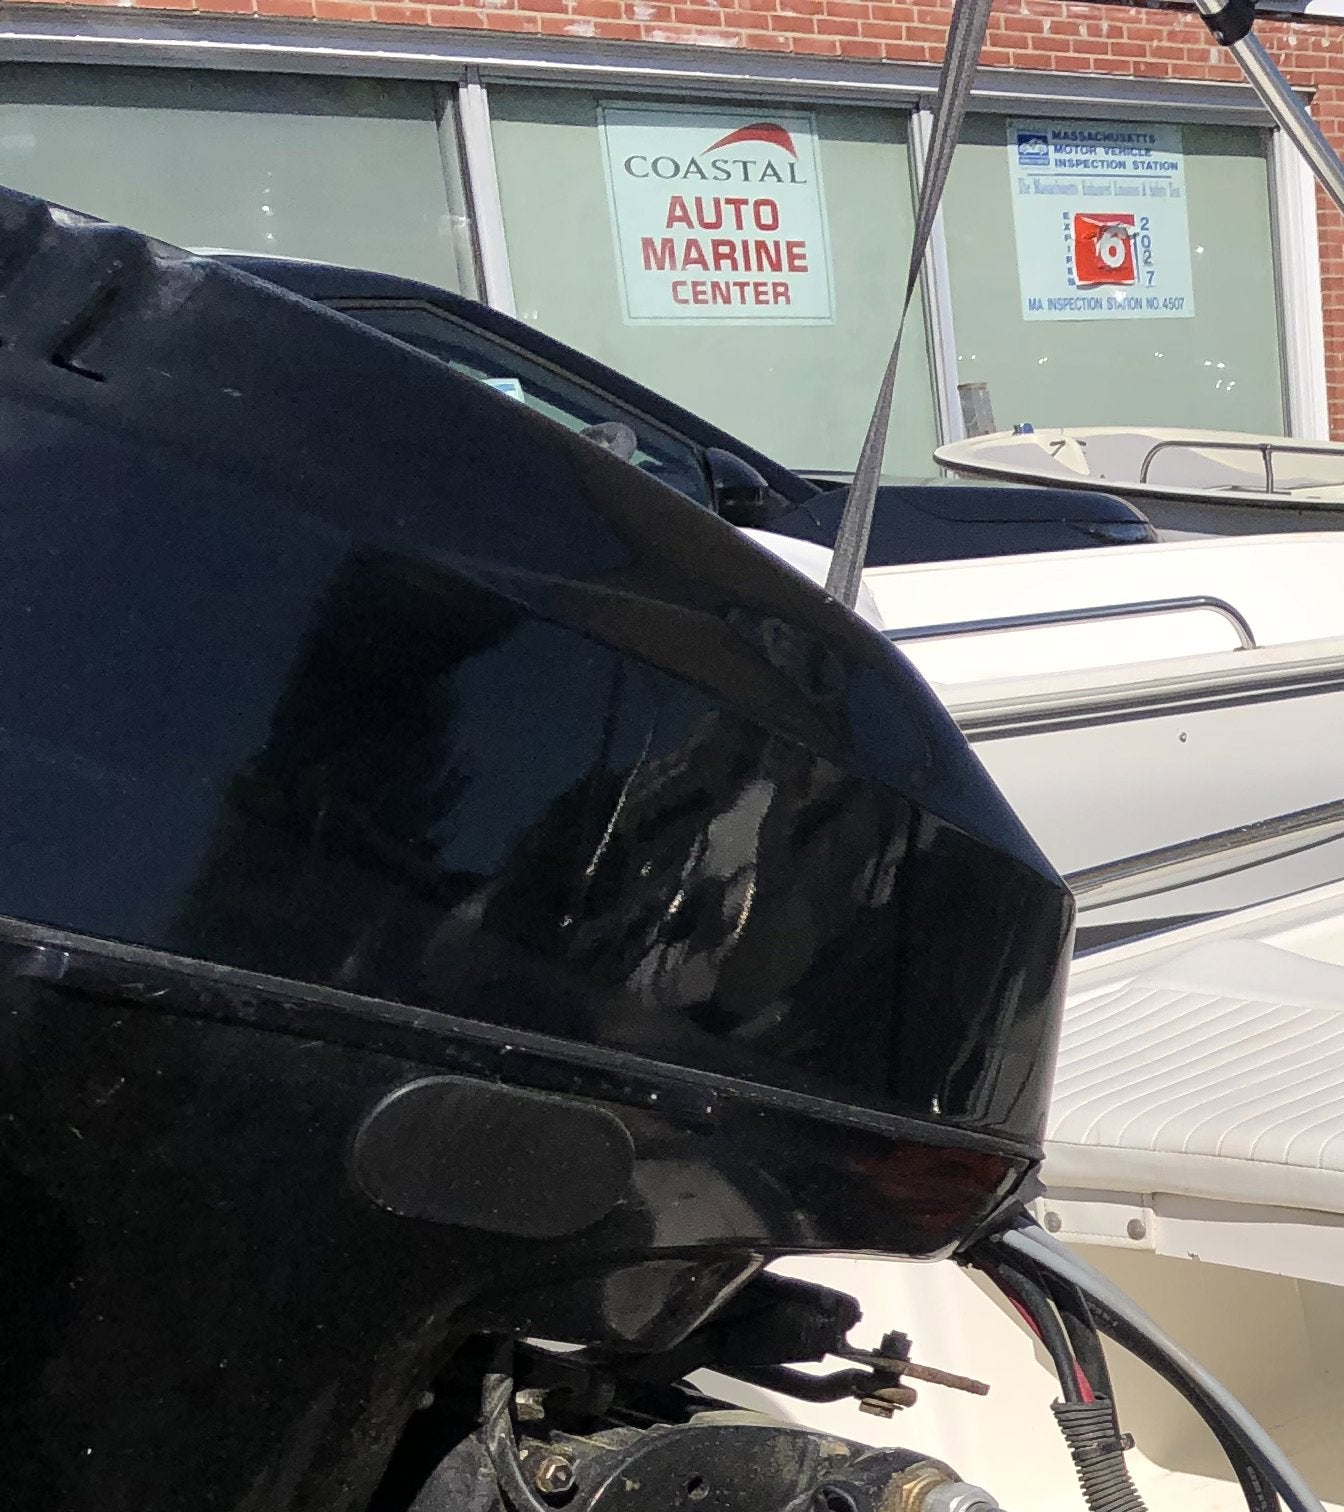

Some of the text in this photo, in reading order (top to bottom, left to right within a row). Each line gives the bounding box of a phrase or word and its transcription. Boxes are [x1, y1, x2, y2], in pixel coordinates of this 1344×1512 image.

[1051, 130, 1156, 144] MASSACHUSETTS
[1053, 145, 1152, 157] MOTOR VEHICLE
[624, 155, 807, 184] COASTAL
[1054, 158, 1179, 171] INSPECTION STATION
[665, 195, 780, 231] AUTO
[640, 237, 809, 273] MARINE
[671, 280, 791, 305] CENTER
[1028, 298, 1043, 311] MA
[1047, 297, 1103, 311] INSPECTION
[1106, 297, 1143, 311] STATION
